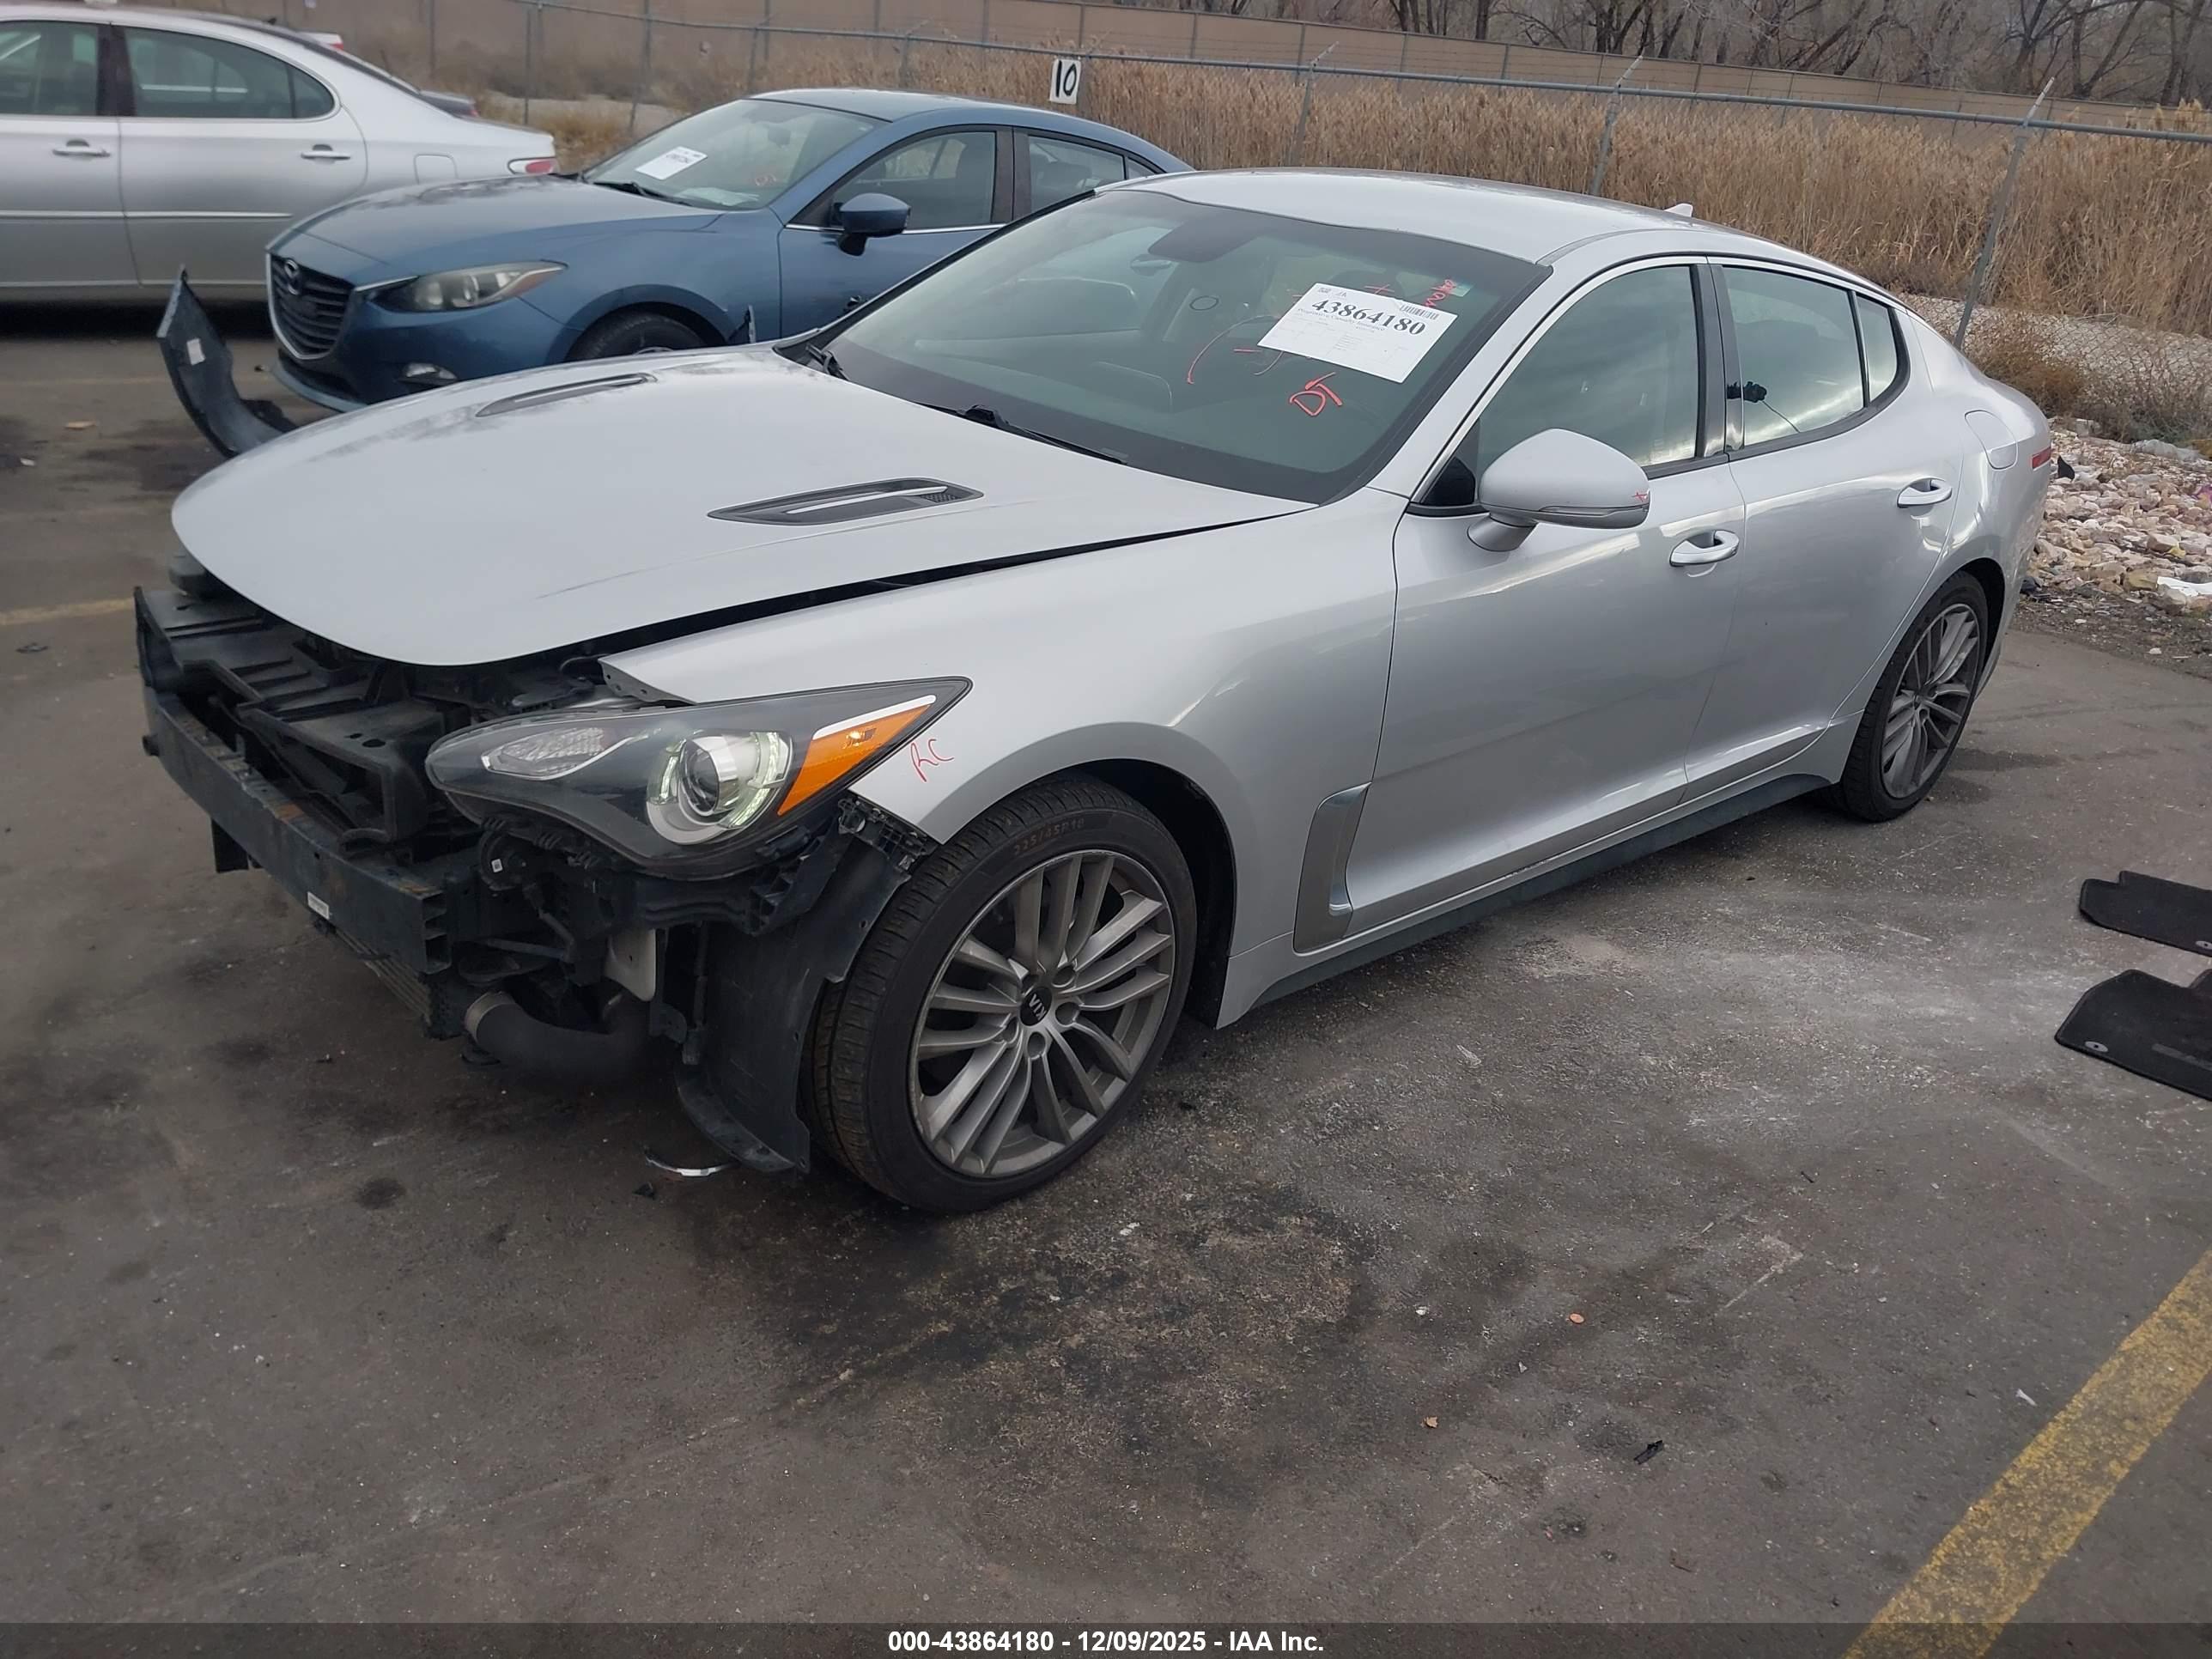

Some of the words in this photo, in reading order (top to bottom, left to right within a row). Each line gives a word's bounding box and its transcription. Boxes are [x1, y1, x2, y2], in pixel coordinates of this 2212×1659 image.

[1055, 60, 1078, 98] 10
[1311, 299, 1426, 335] 43864180
[1029, 993, 1048, 1022] KIA
